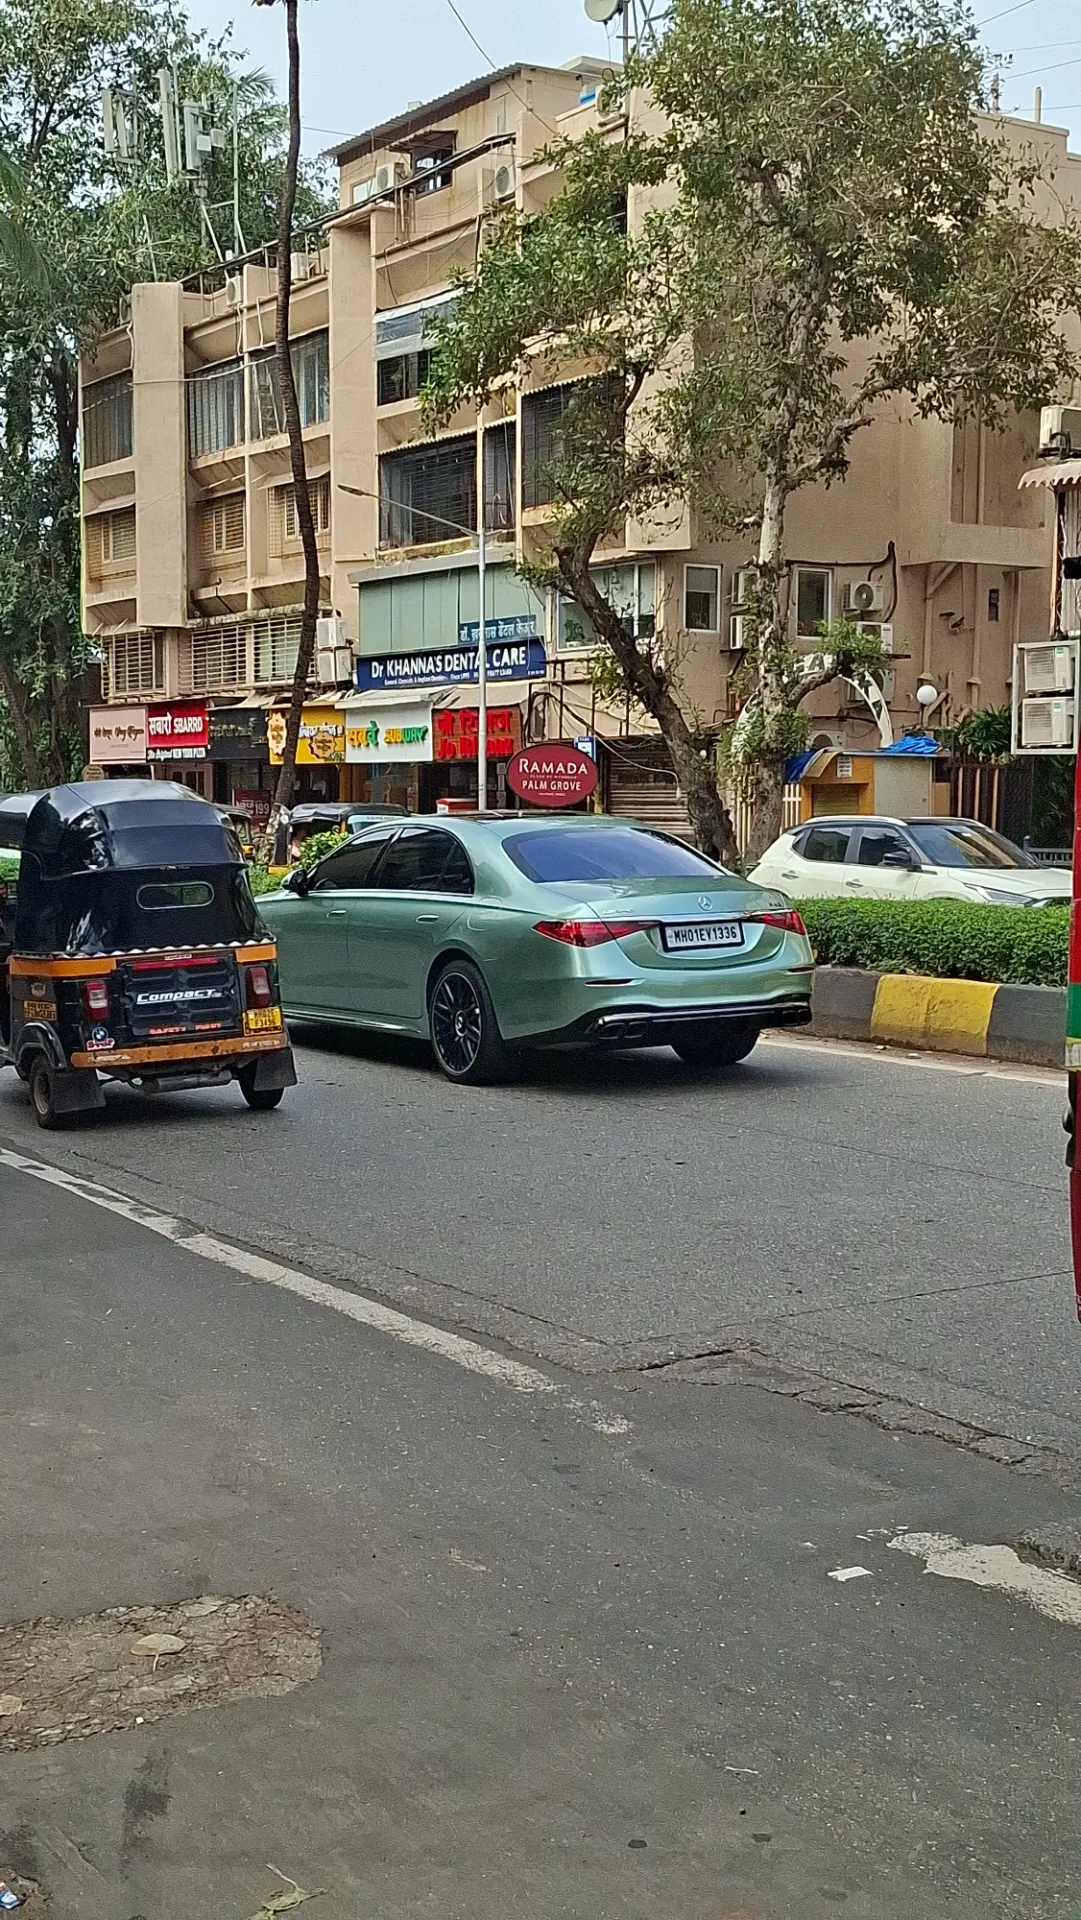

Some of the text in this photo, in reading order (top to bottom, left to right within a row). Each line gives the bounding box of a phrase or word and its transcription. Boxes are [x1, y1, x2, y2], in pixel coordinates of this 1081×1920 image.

[371, 661, 384, 678] Dr
[387, 655, 443, 677] KHANNA'S
[492, 646, 527, 667] CARE
[174, 716, 203, 734] SBARRO
[347, 720, 380, 747] सबवे
[383, 725, 429, 745] SUBWAY
[522, 780, 581, 791] PALM GROVE
[673, 926, 737, 944] MH01EV1336
